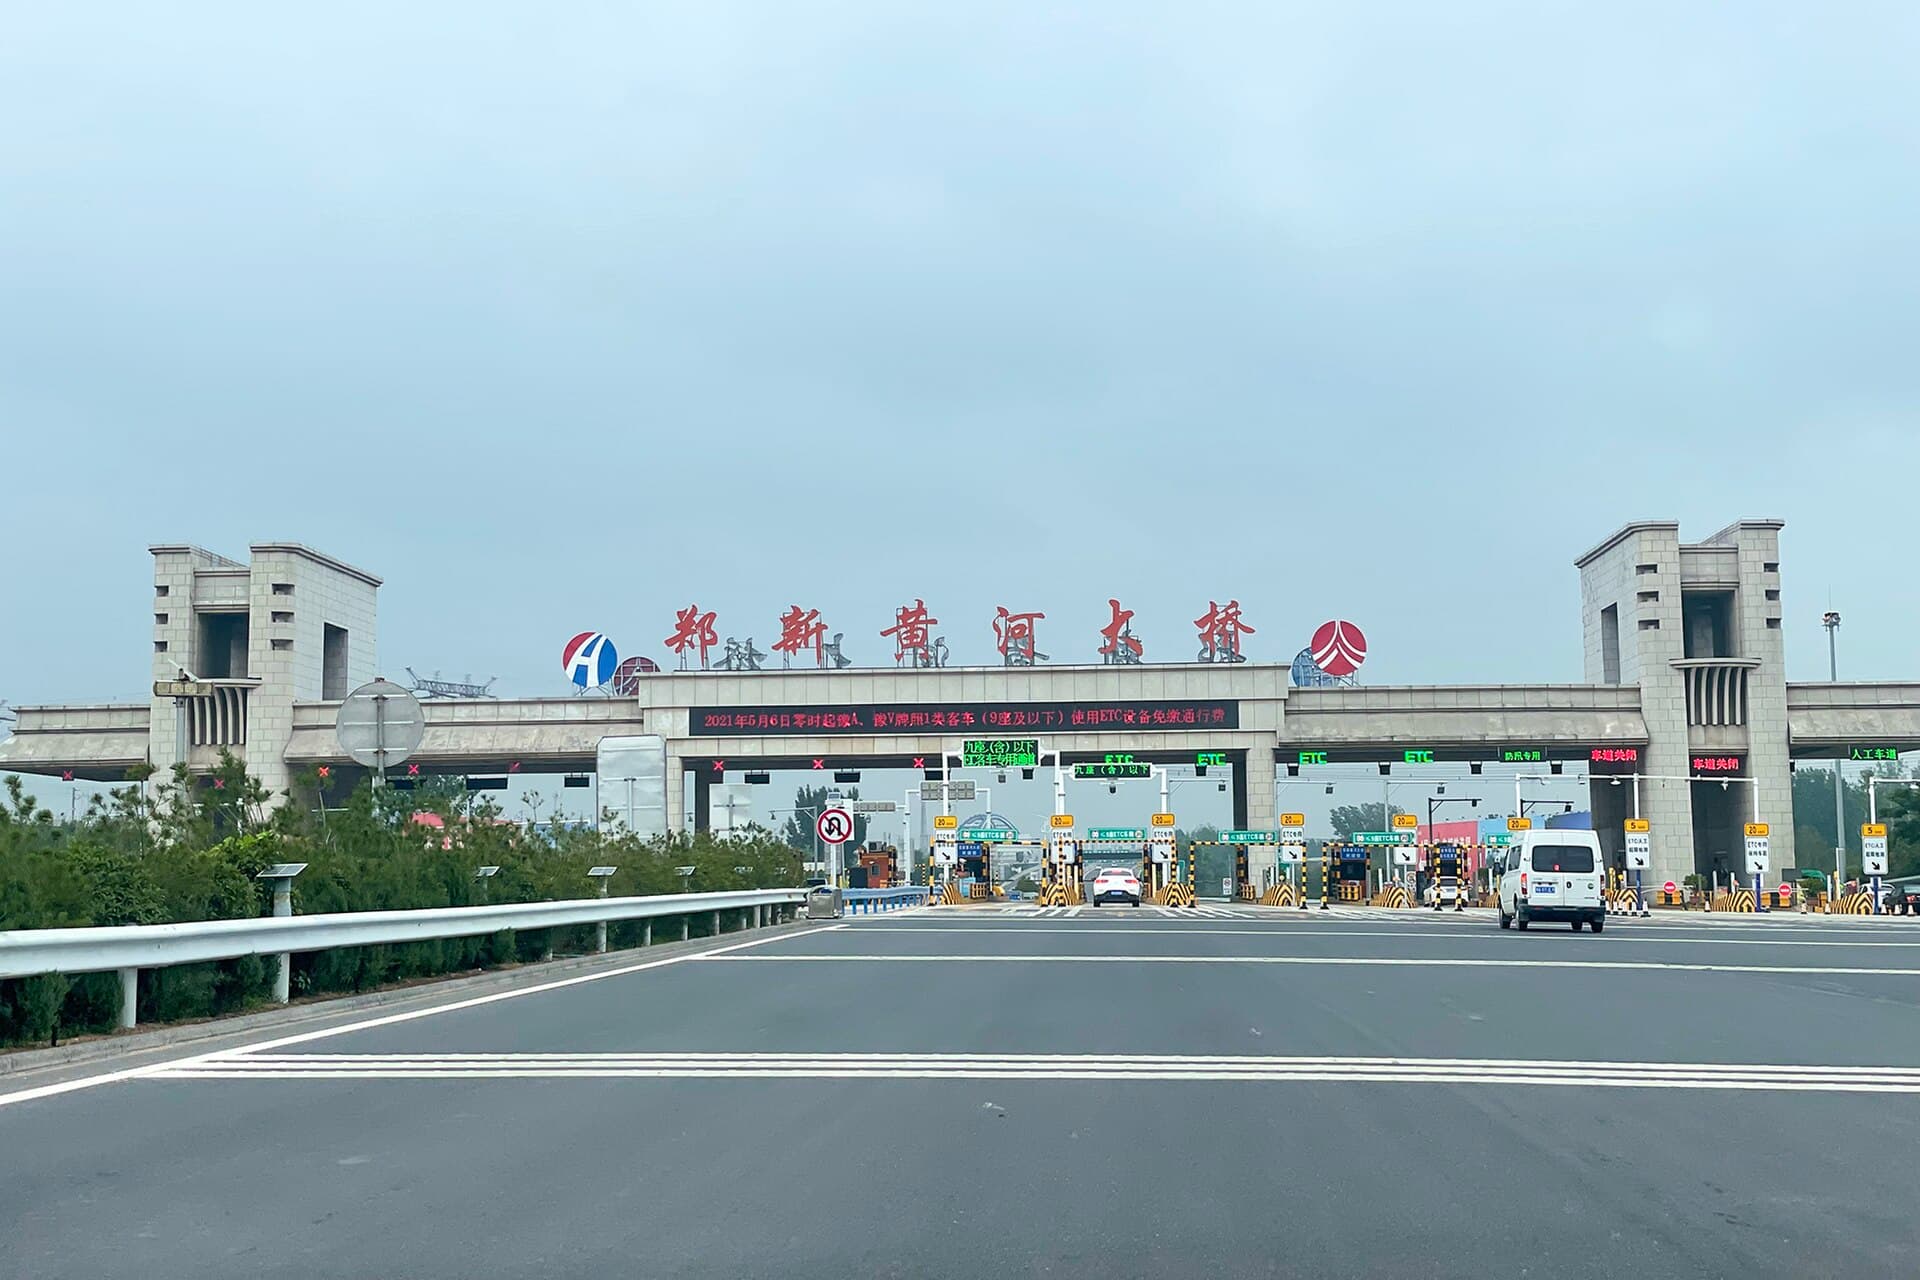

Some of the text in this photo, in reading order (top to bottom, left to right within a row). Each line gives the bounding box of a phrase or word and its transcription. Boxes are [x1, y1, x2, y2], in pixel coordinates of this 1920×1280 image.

[664, 599, 1256, 668] 郑新黄河大桥
[1196, 753, 1226, 766] ETC
[1299, 751, 1327, 764] ETC
[1404, 751, 1433, 763] ETC
[1591, 749, 1638, 762] 车道关闭
[1852, 748, 1897, 760] 人工车道
[1693, 758, 1739, 770] 车道关闭
